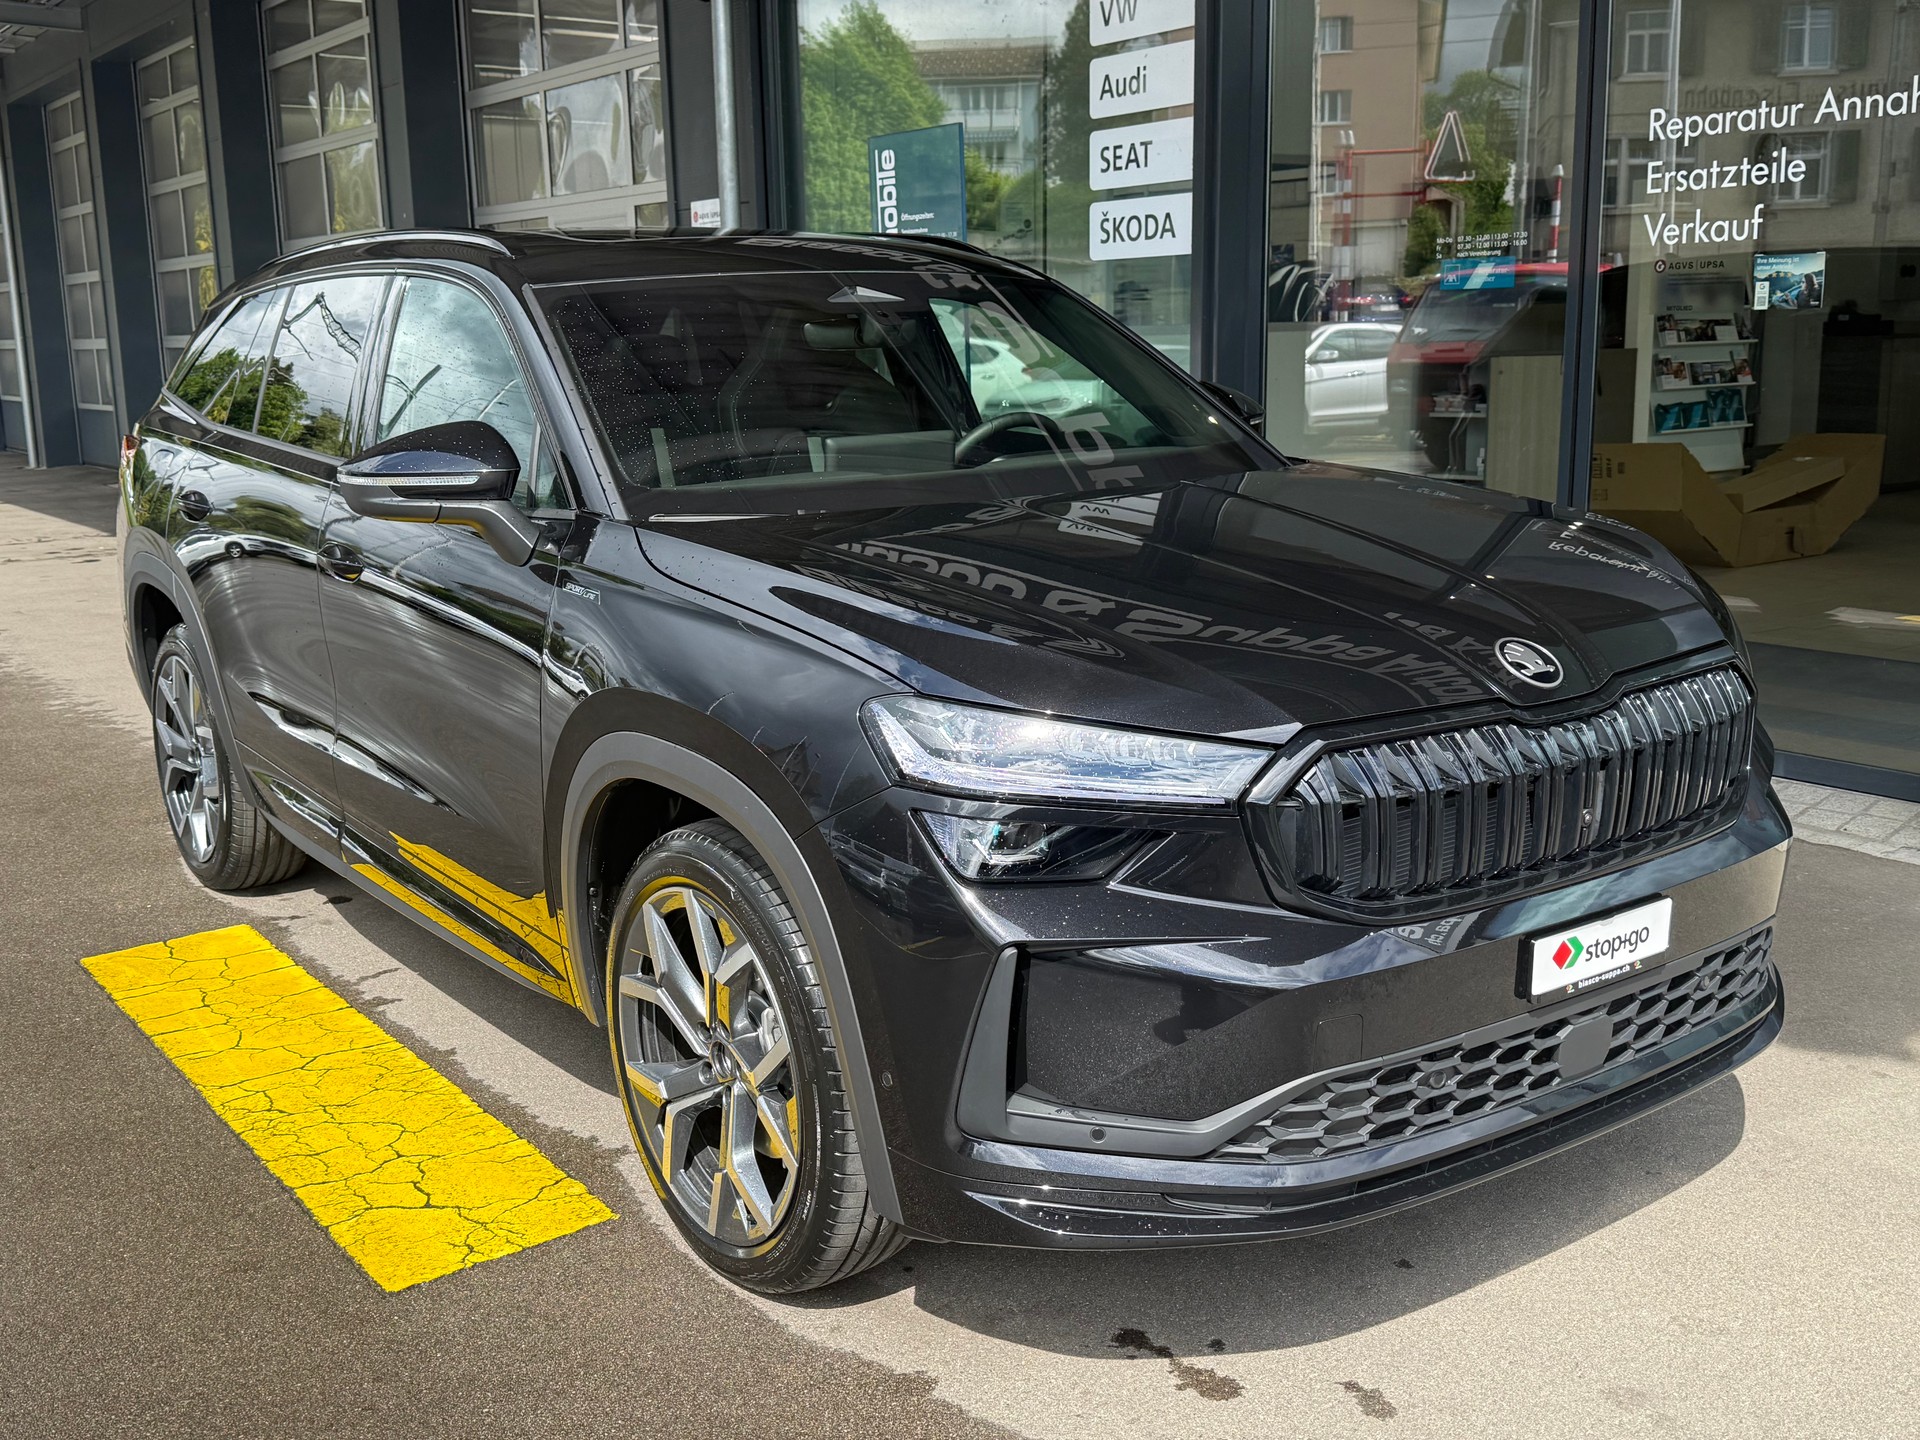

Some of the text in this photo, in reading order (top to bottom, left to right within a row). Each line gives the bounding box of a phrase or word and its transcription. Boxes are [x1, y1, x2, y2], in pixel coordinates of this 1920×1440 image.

[1099, 65, 1147, 101] Audi
[1648, 100, 1805, 147] Reparatur
[1099, 140, 1153, 173] SEAT
[1646, 146, 1807, 194] Ersatzteile
[878, 149, 899, 234] obile
[1099, 211, 1177, 245] ŠKODA
[1643, 203, 1765, 247] Verkauf
[1668, 260, 1725, 270] AGVS UPSA
[1585, 926, 1650, 962] stop+go
[1578, 964, 1630, 989] biasco-suppa.ch
